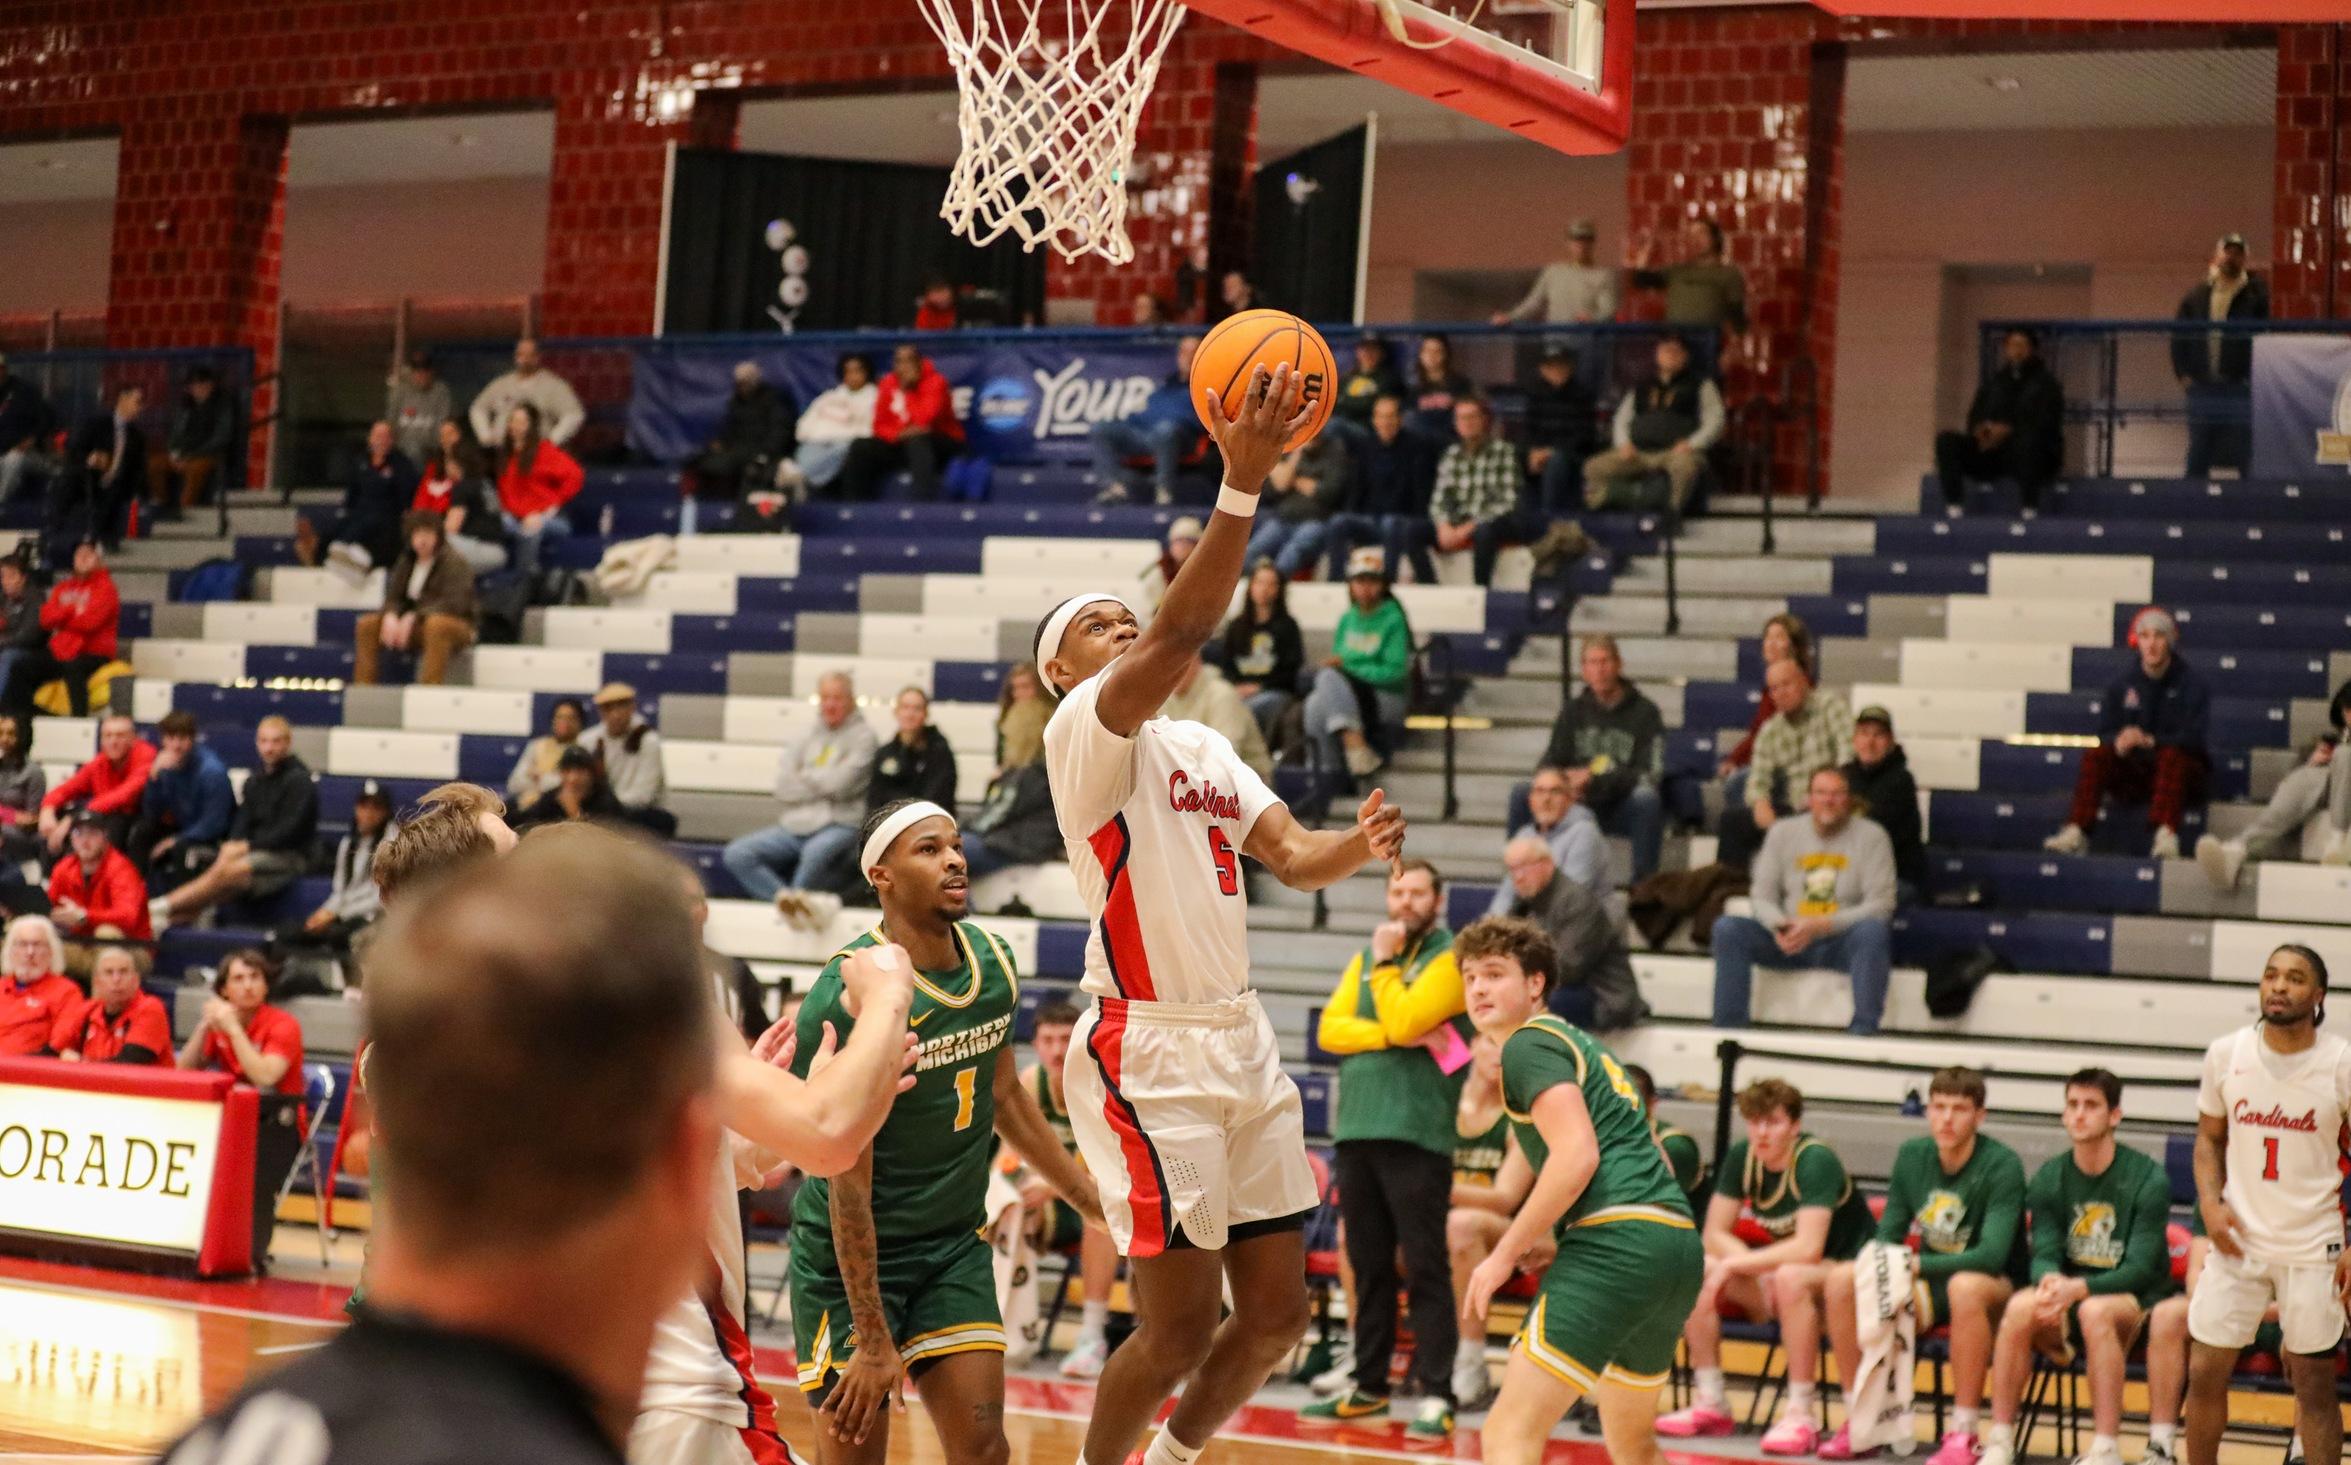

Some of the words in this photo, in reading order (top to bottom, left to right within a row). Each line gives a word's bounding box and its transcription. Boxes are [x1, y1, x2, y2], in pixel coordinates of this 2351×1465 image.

[1207, 825, 1239, 896] 5
[953, 1066, 978, 1132] 1
[2233, 1098, 2318, 1133] Cardinals
[0, 1125, 196, 1199] ORADE
[2262, 1136, 2280, 1181] 1
